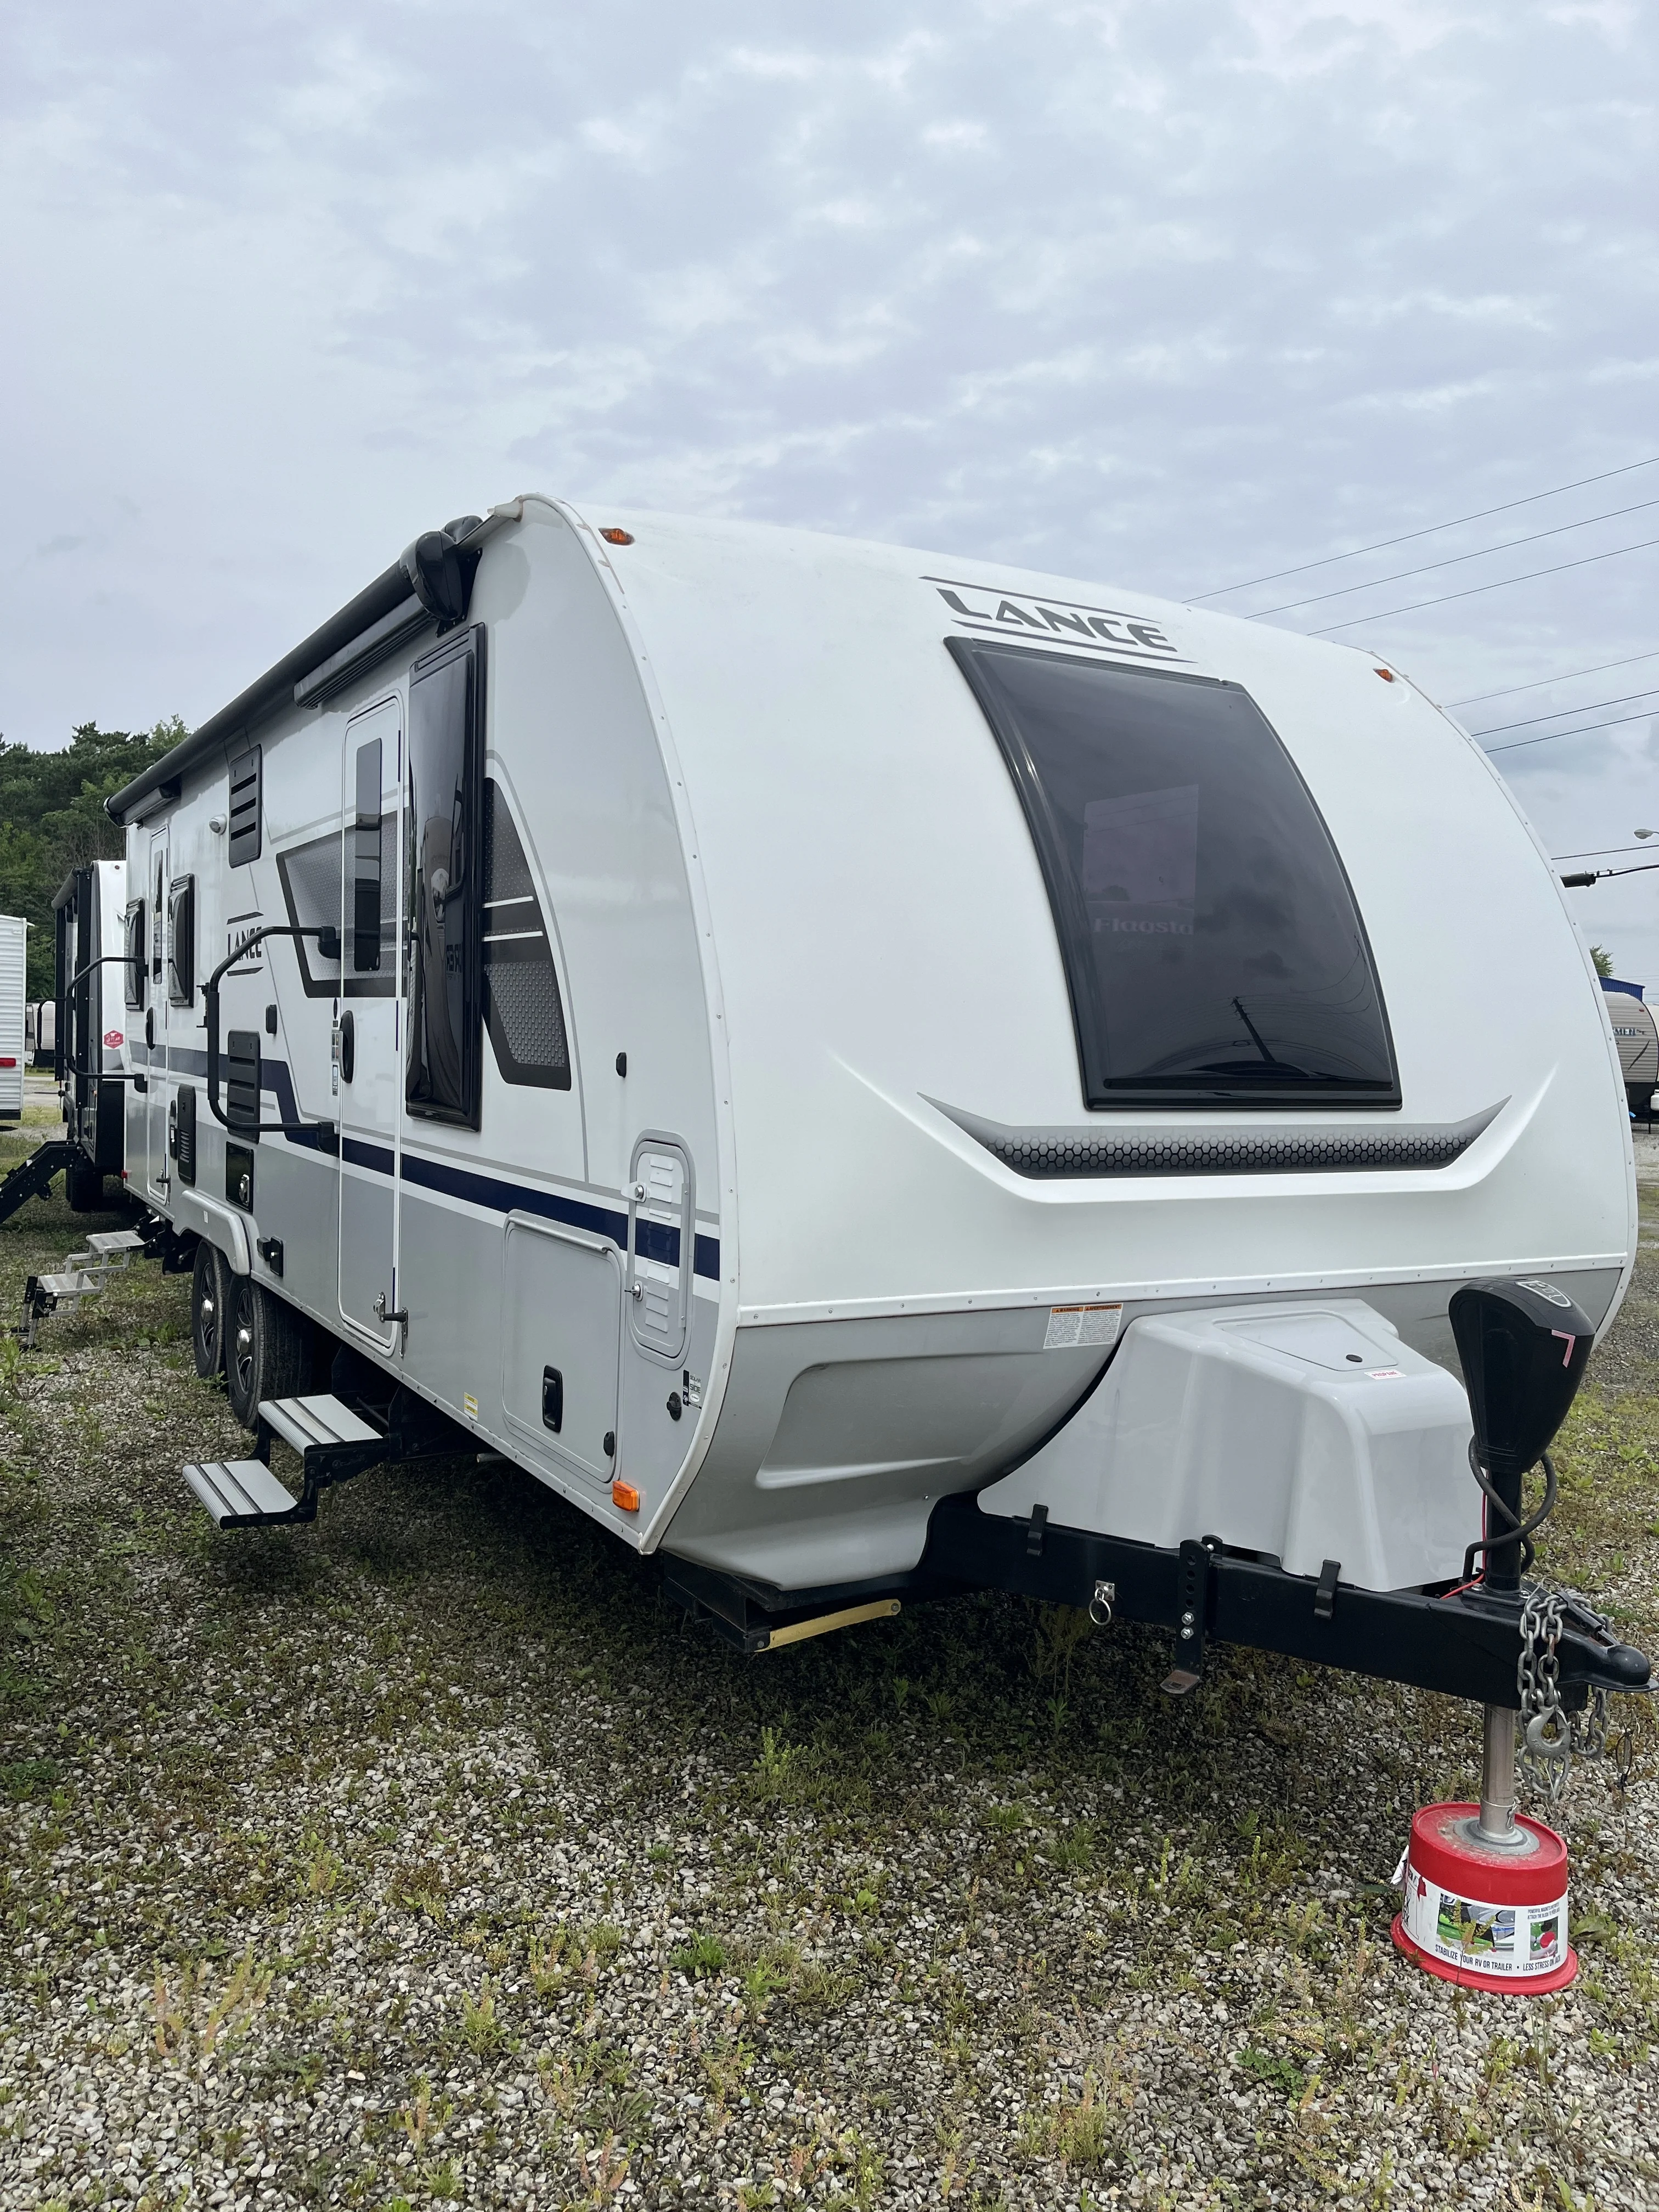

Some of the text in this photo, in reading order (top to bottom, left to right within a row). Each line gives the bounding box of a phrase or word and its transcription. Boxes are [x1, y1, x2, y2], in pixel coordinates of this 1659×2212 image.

[936, 588, 1178, 652] LANCE
[690, 1375, 701, 1383] SOLAR
[690, 1383, 701, 1393] SIDE
[1435, 1944, 1513, 1971] STABILIZE YOUR RV OR TRAILER
[1523, 1962, 1534, 1971] LESS
[1534, 1959, 1549, 1970] STRESS
[1549, 1958, 1555, 1966] ON
